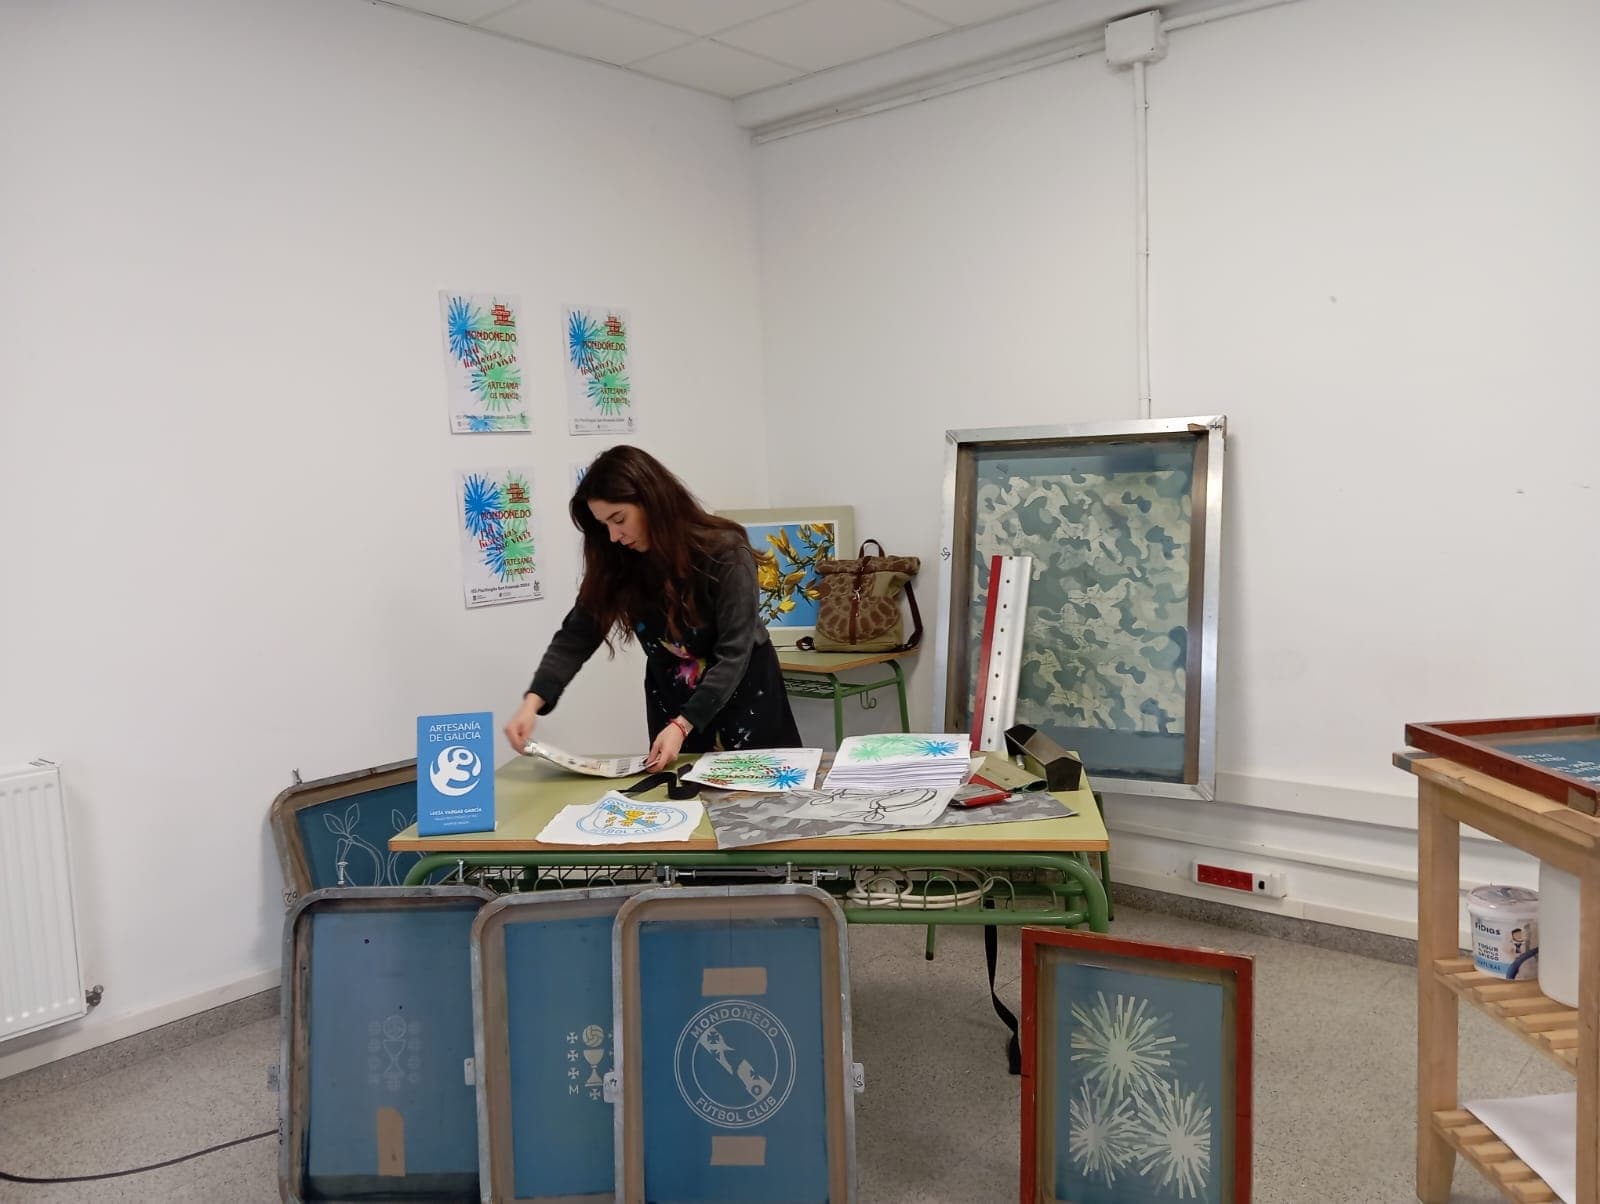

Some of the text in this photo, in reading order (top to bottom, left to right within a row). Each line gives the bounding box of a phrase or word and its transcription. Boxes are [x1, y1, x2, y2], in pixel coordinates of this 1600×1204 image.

[429, 721, 481, 732] ARTESANÍA
[429, 731, 481, 742] DE GALICIA
[747, 1096, 776, 1120] CLUB
